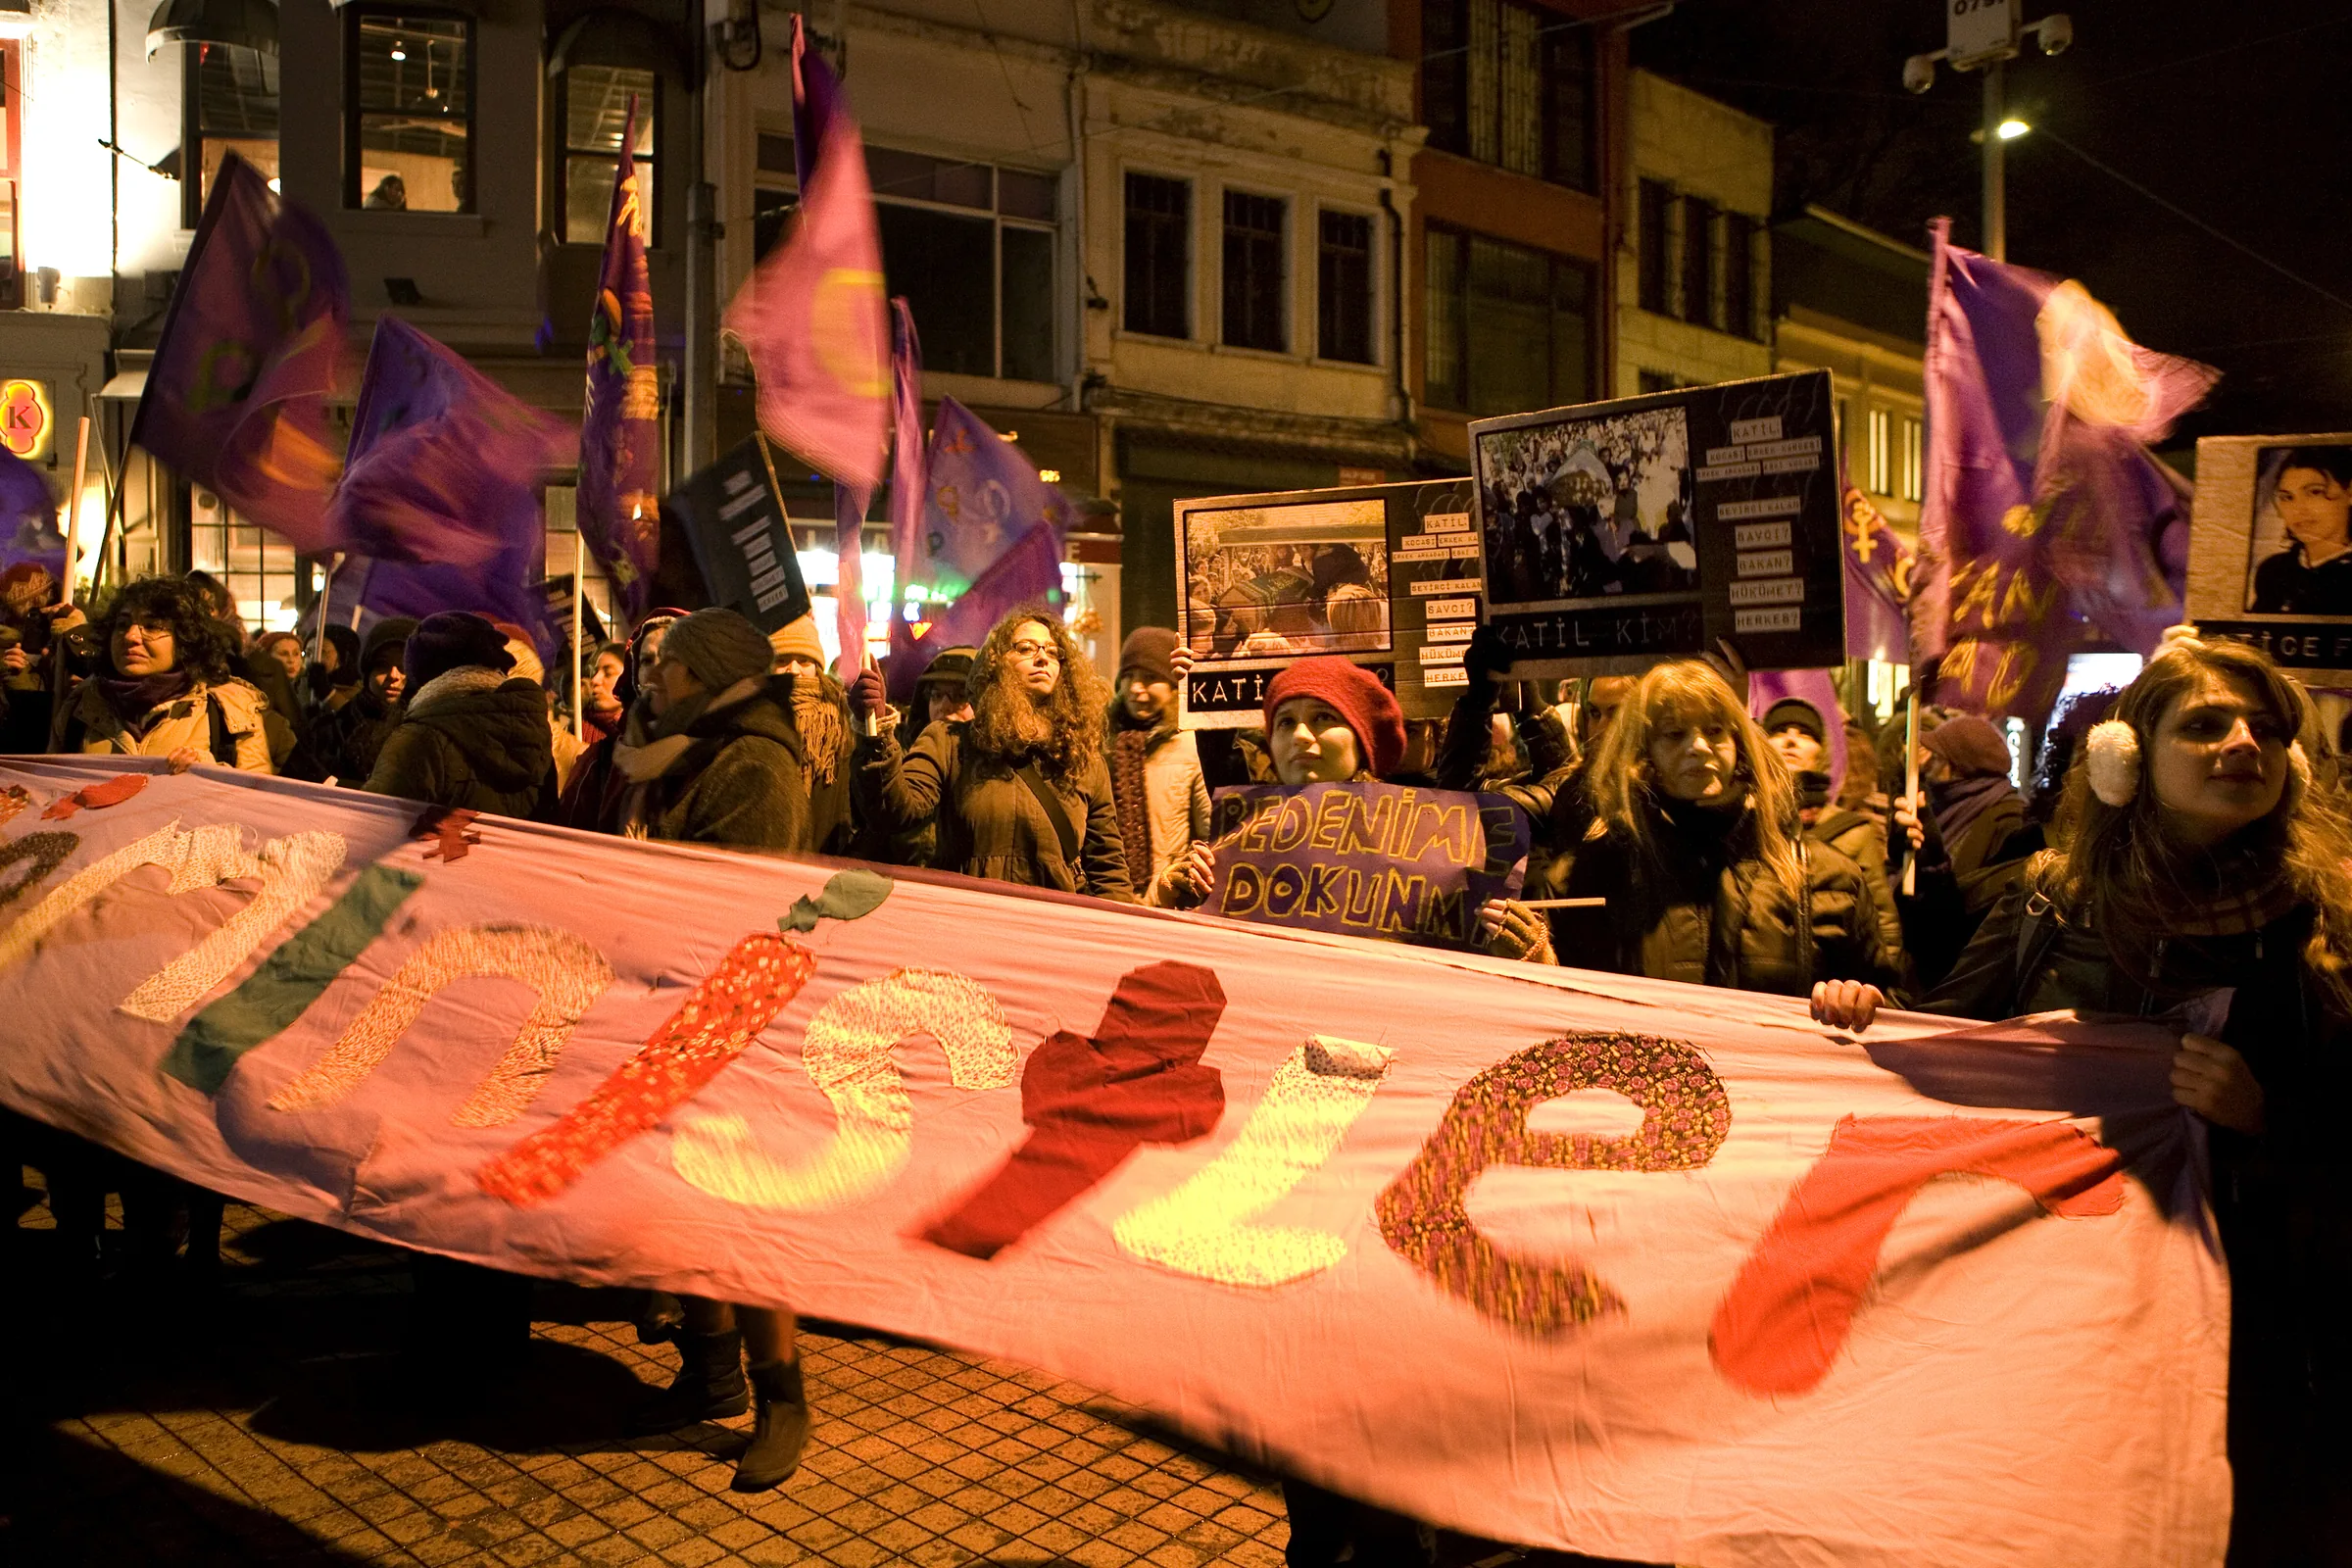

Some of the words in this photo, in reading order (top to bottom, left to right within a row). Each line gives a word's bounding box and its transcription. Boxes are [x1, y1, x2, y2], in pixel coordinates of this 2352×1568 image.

[8, 406, 32, 429] K
[1427, 516, 1468, 529] KATİL:
[1427, 602, 1473, 614] SAVCI?
[1420, 648, 1466, 660] HÜKÜME
[1426, 671, 1467, 683] HERKE
[1192, 673, 1264, 704] KATİ
[1218, 787, 1517, 878] BEDENİME
